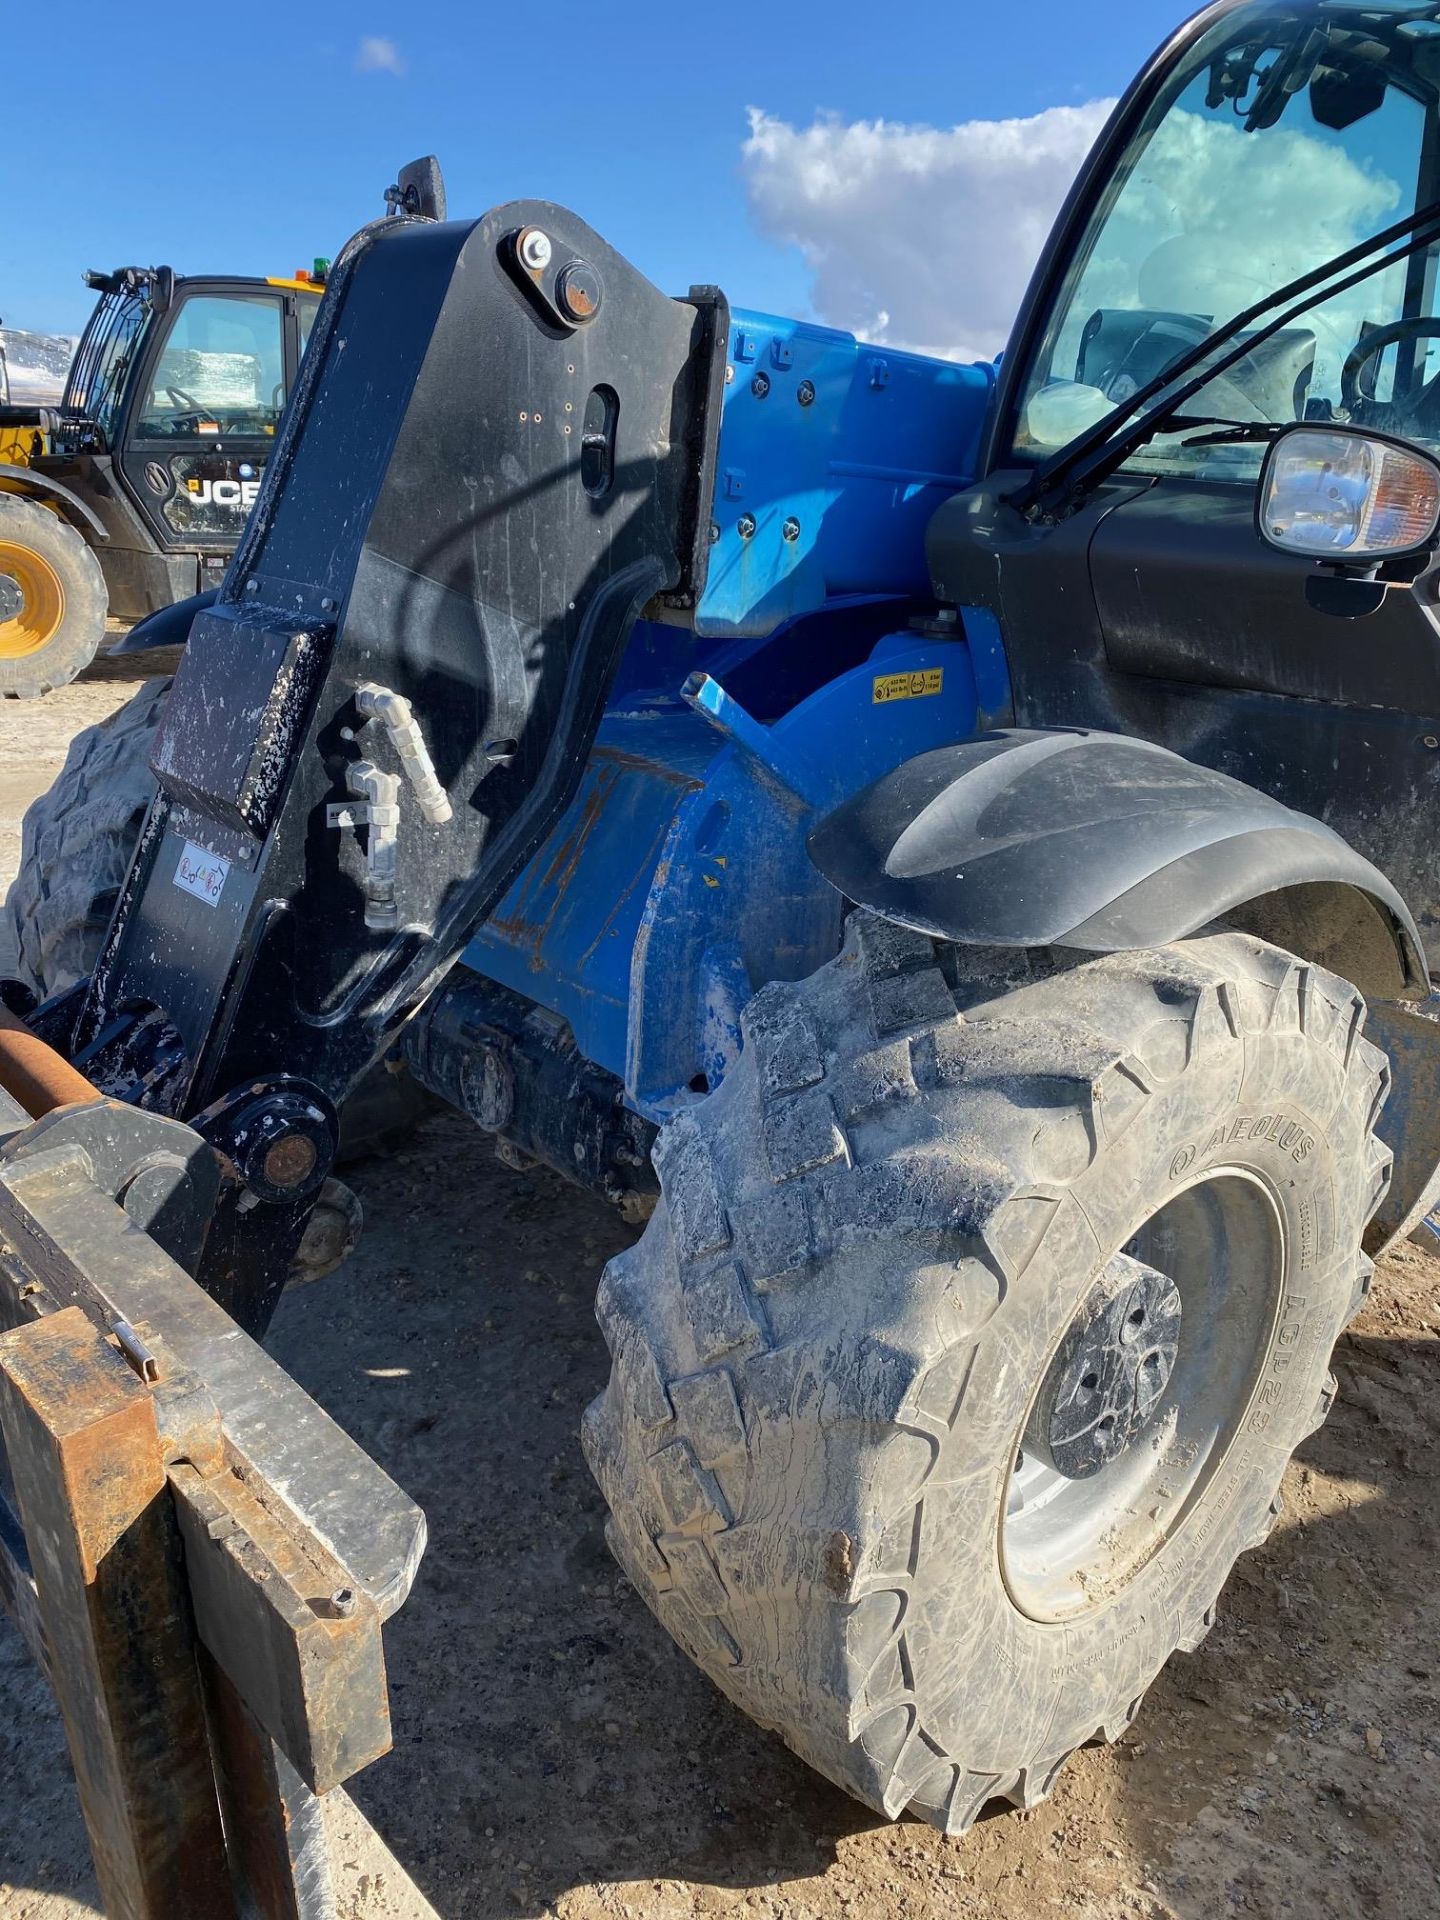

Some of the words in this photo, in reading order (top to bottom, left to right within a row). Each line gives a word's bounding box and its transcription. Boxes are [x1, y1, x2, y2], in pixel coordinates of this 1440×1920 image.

[1201, 1113, 1315, 1163] AEOLUS
[1247, 1295, 1306, 1434] AGP23
[1214, 1474, 1239, 1511] STEEL
